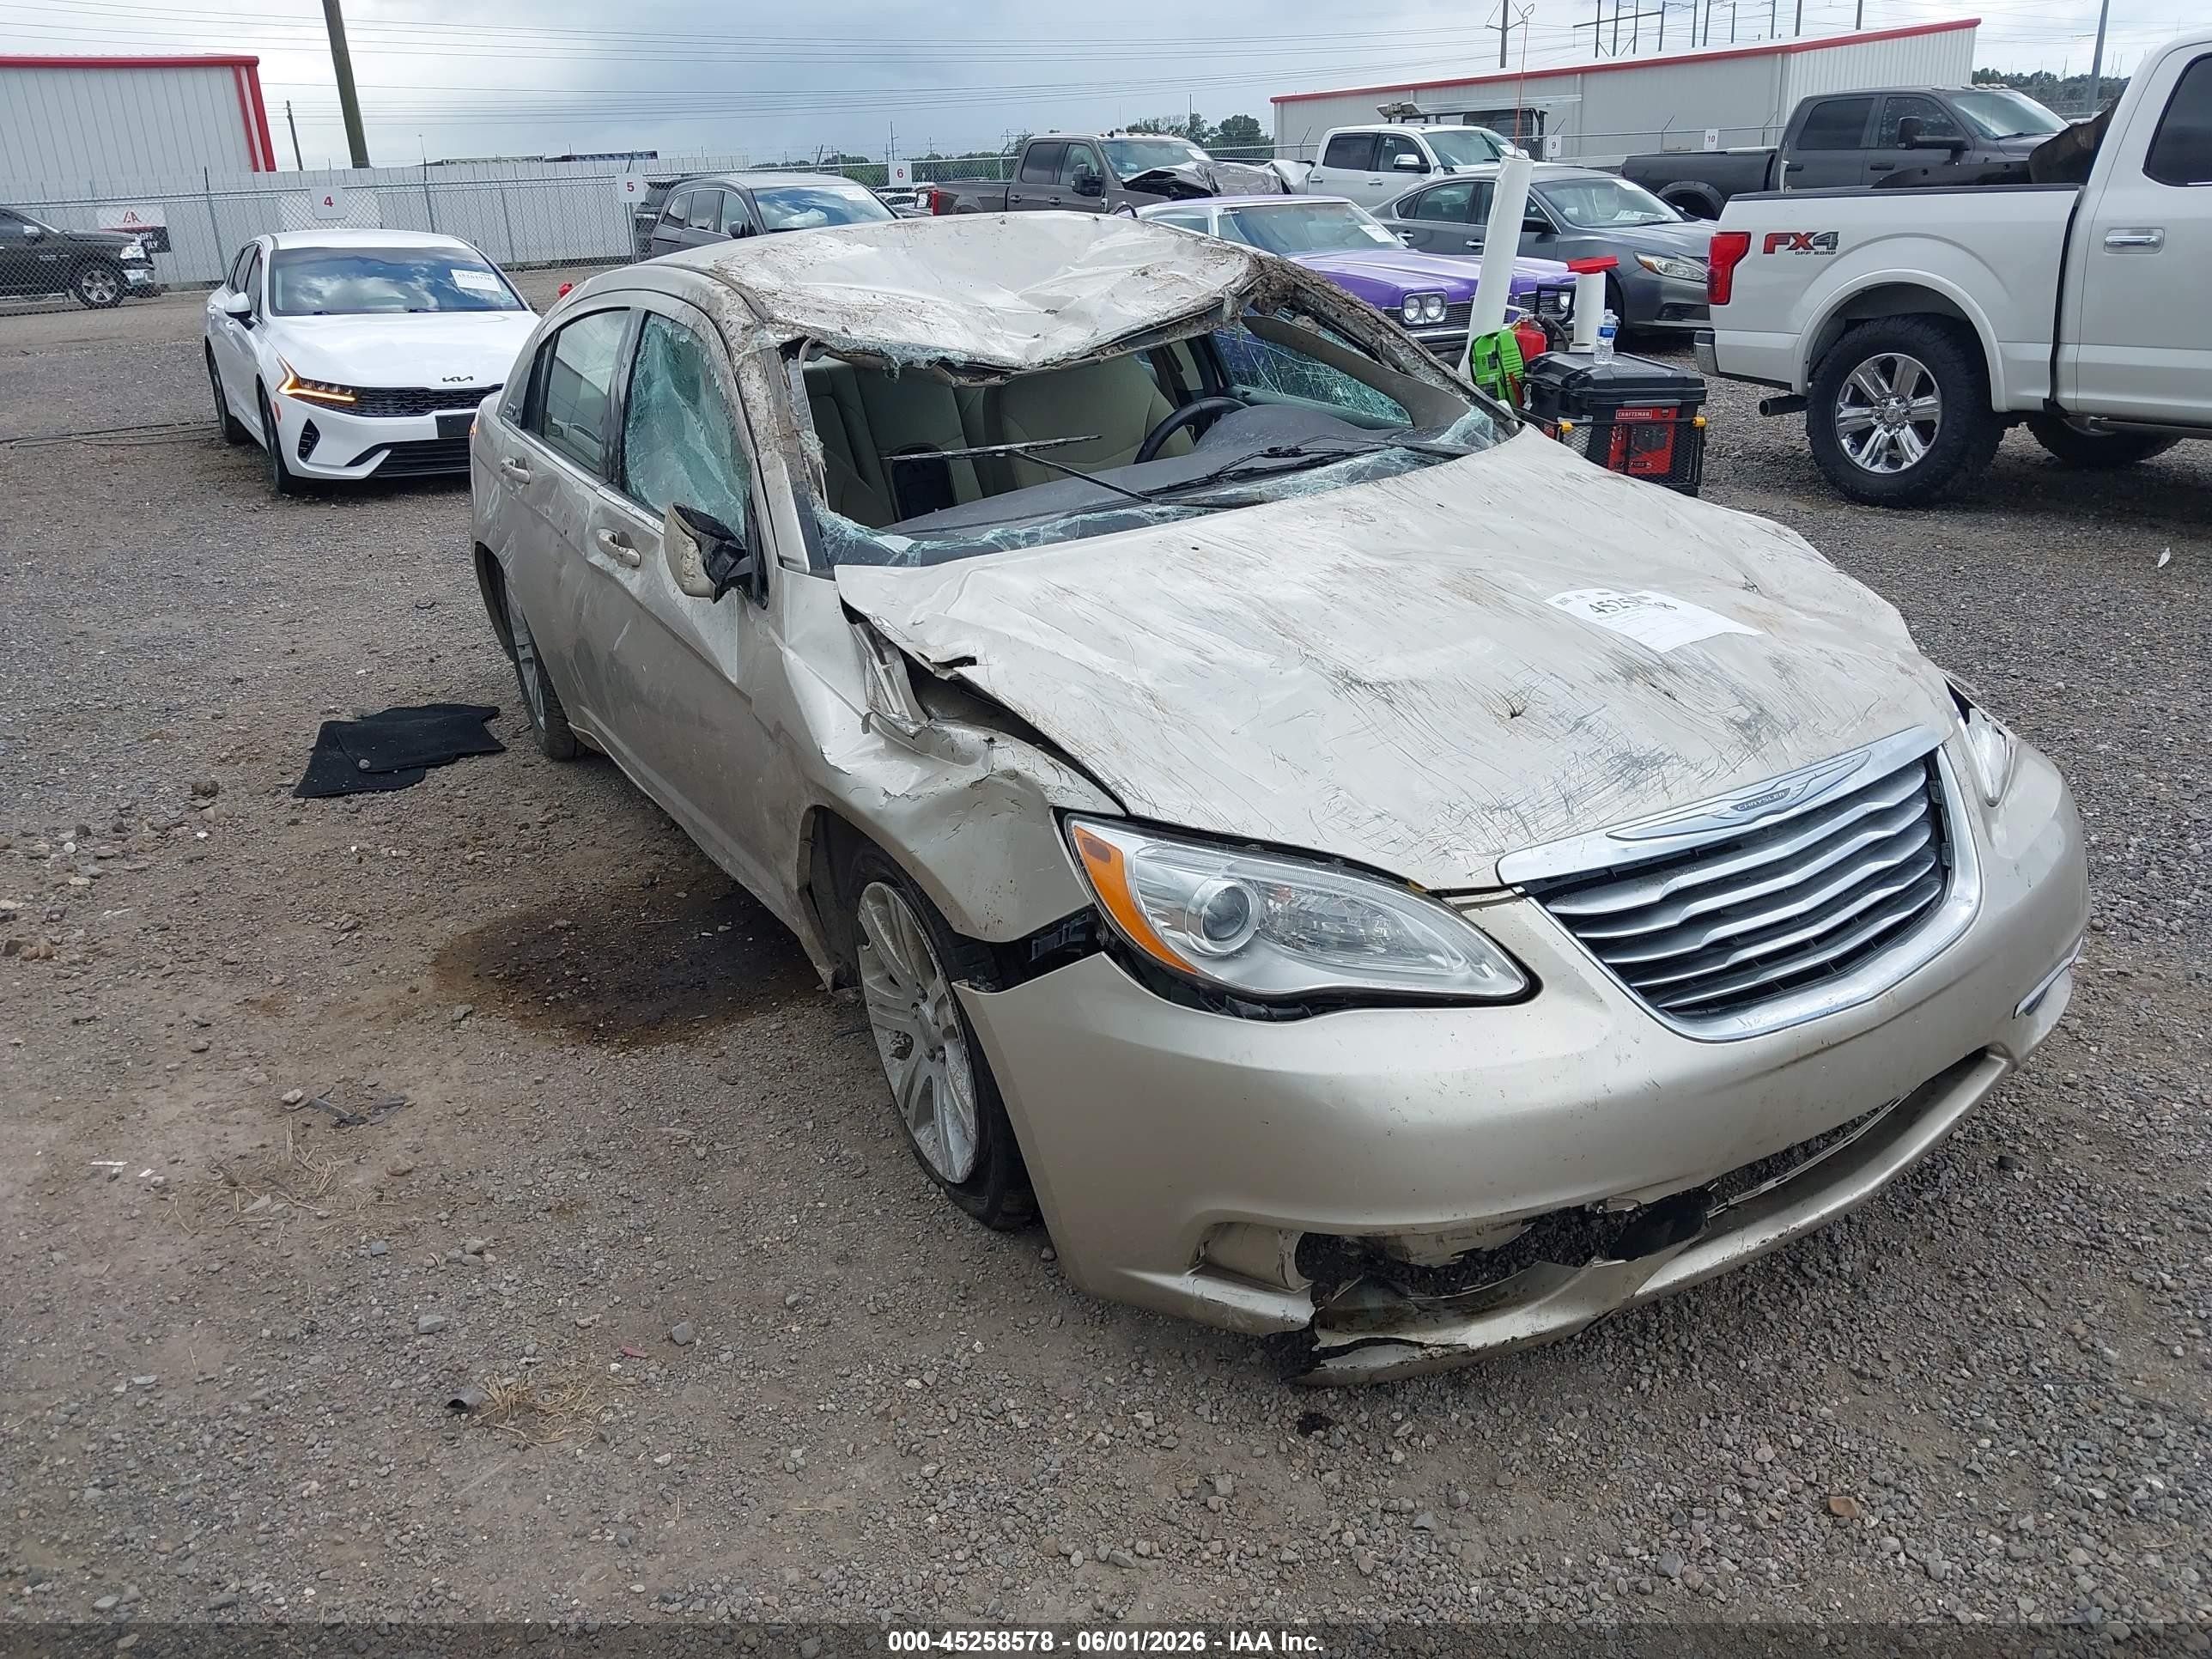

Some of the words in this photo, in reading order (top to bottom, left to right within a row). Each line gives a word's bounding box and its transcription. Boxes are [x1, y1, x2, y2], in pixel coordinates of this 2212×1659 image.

[1551, 141, 1557, 150] 9
[896, 168, 904, 179] 6
[626, 181, 635, 191] 5
[324, 196, 334, 207] 4
[1763, 231, 1839, 254] FX4
[1737, 792, 1785, 811] CHRYSLER
